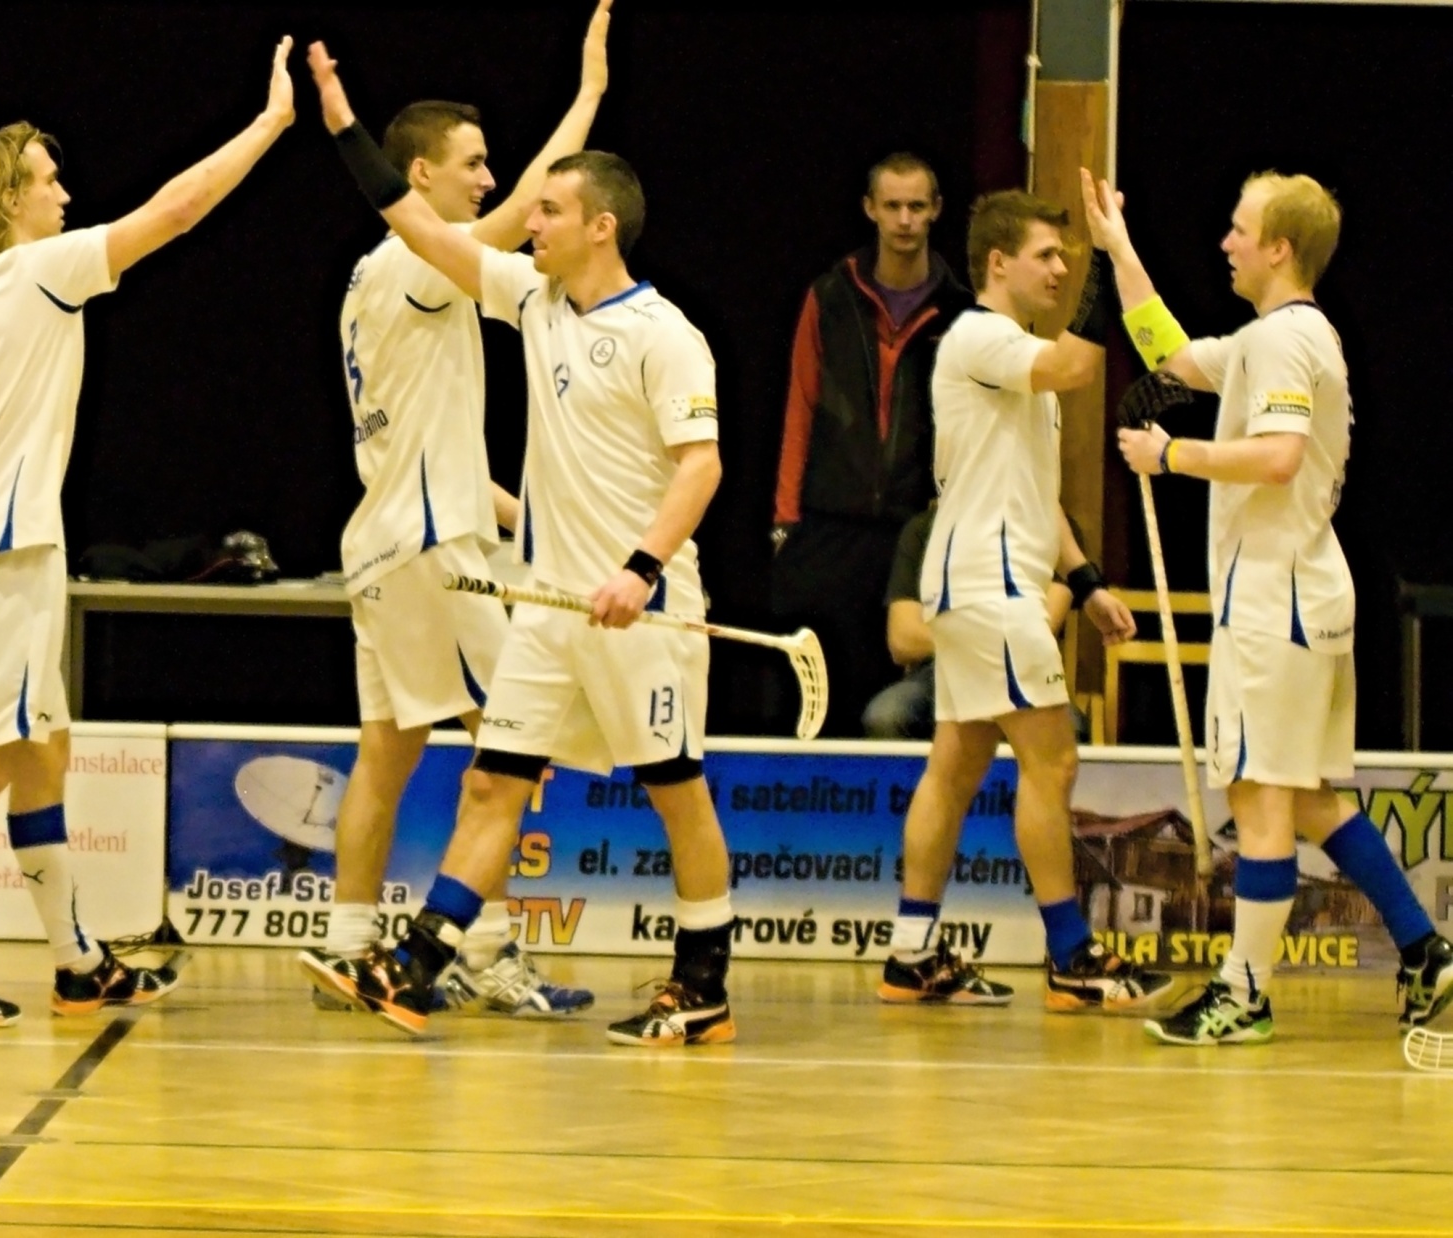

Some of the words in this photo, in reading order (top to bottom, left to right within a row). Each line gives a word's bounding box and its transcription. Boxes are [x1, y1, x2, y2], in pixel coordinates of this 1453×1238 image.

[649, 686, 675, 728] 13
[67, 827, 127, 853] ětlení
[579, 838, 619, 876] el.
[633, 844, 882, 888] zapečovací
[187, 872, 280, 901] Josef
[185, 908, 250, 938] 777
[263, 911, 331, 940] 805
[631, 904, 817, 946] karové
[830, 917, 993, 960] sysmy
